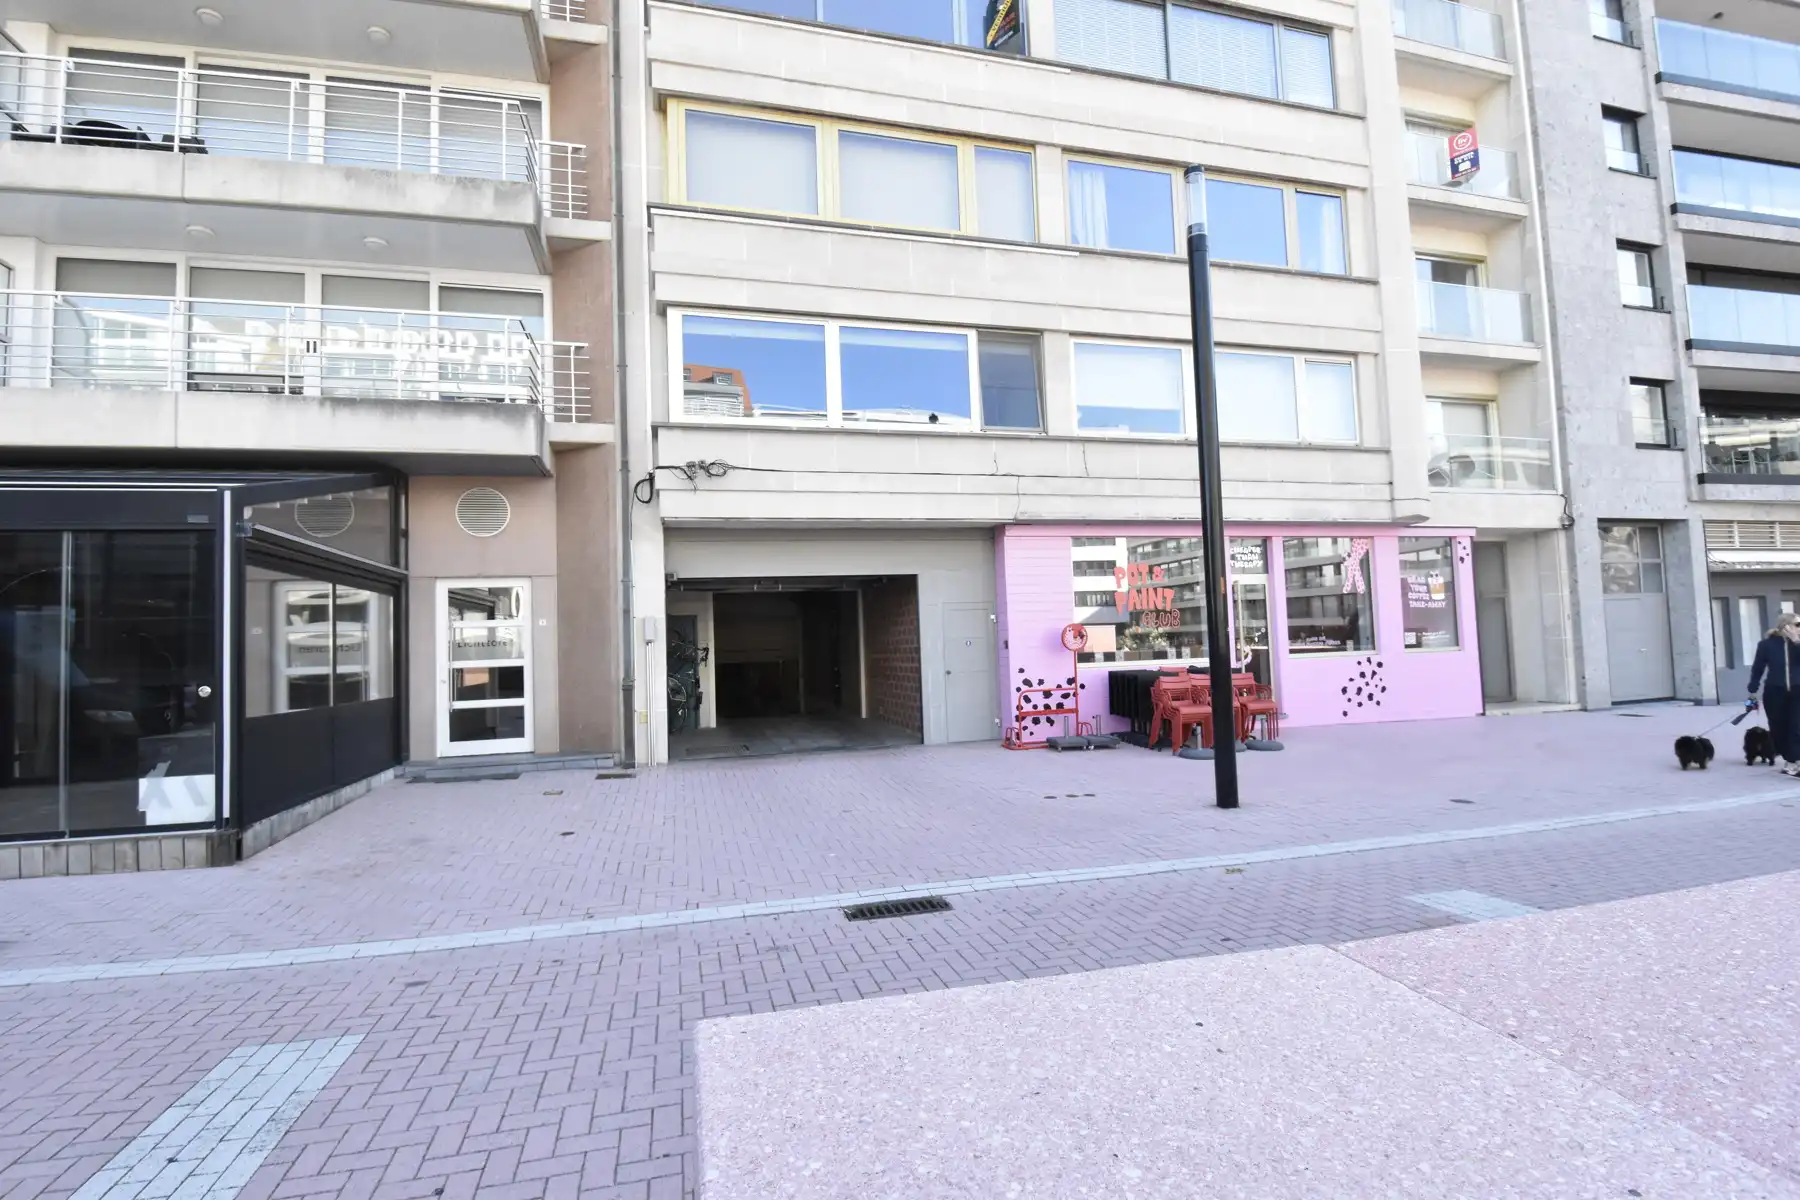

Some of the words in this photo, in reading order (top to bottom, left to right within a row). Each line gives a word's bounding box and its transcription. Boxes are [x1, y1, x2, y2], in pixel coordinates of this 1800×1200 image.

[1113, 563, 1149, 589] POT
[1152, 565, 1166, 582] &
[1114, 587, 1175, 617] PAINT
[1409, 600, 1446, 608] TAKE-AWAY
[1142, 608, 1181, 629] CLUB
